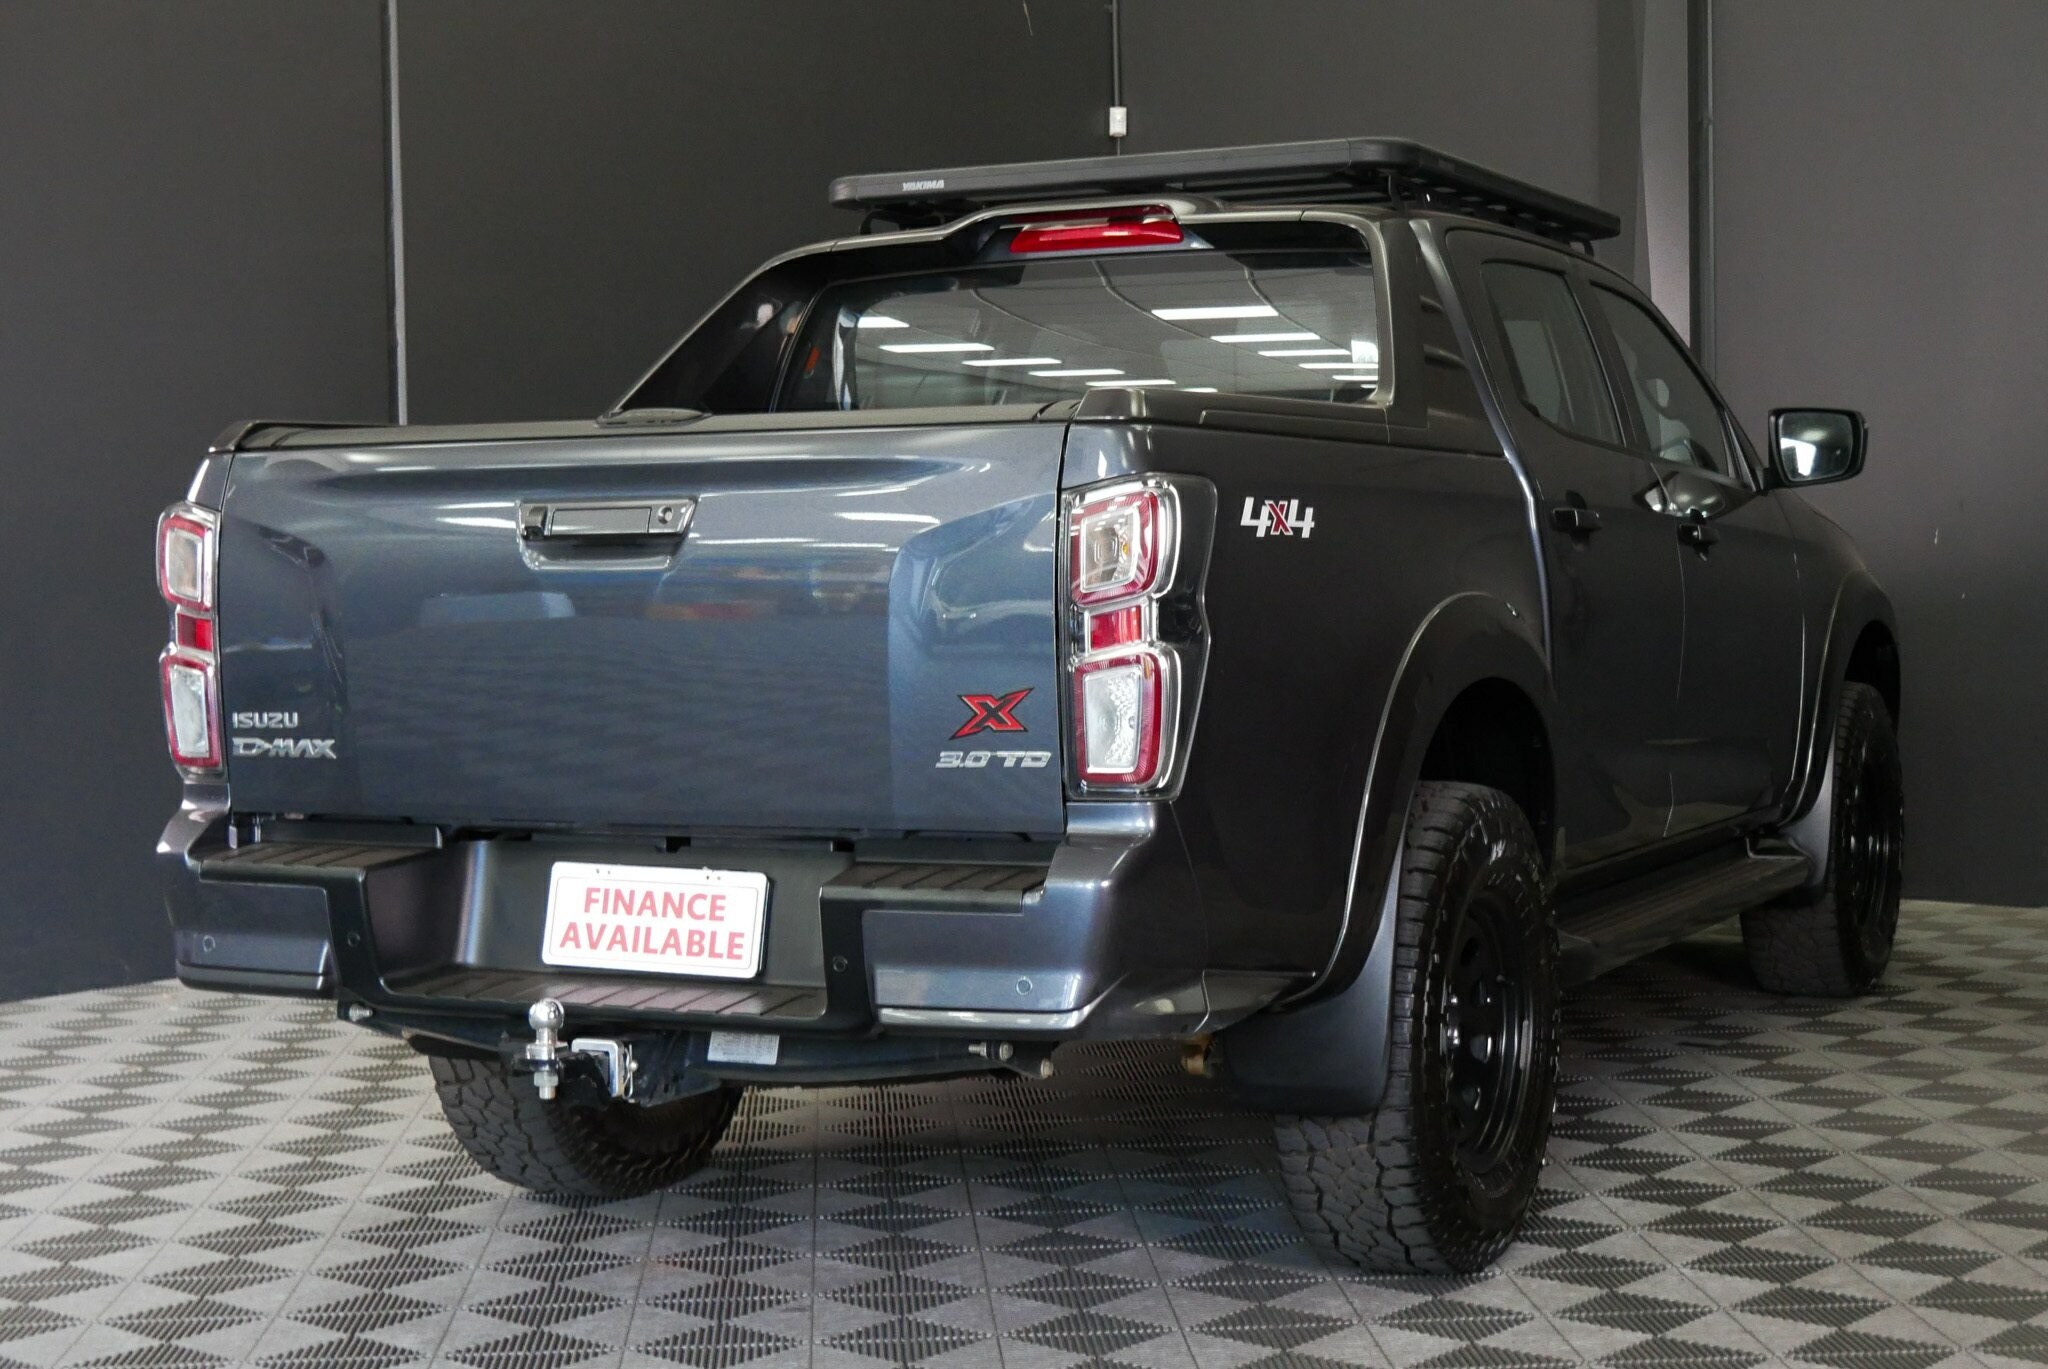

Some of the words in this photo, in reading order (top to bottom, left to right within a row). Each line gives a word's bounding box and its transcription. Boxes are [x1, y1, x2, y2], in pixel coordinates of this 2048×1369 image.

[902, 180, 945, 192] YAKIMA
[232, 712, 299, 728] ISUZU
[948, 687, 1035, 740] X
[232, 737, 337, 759] D-MAX
[935, 750, 991, 768] 3.0
[996, 750, 1051, 768] TD
[584, 887, 726, 922] FINANCE
[559, 922, 745, 960] AVAILABLE
